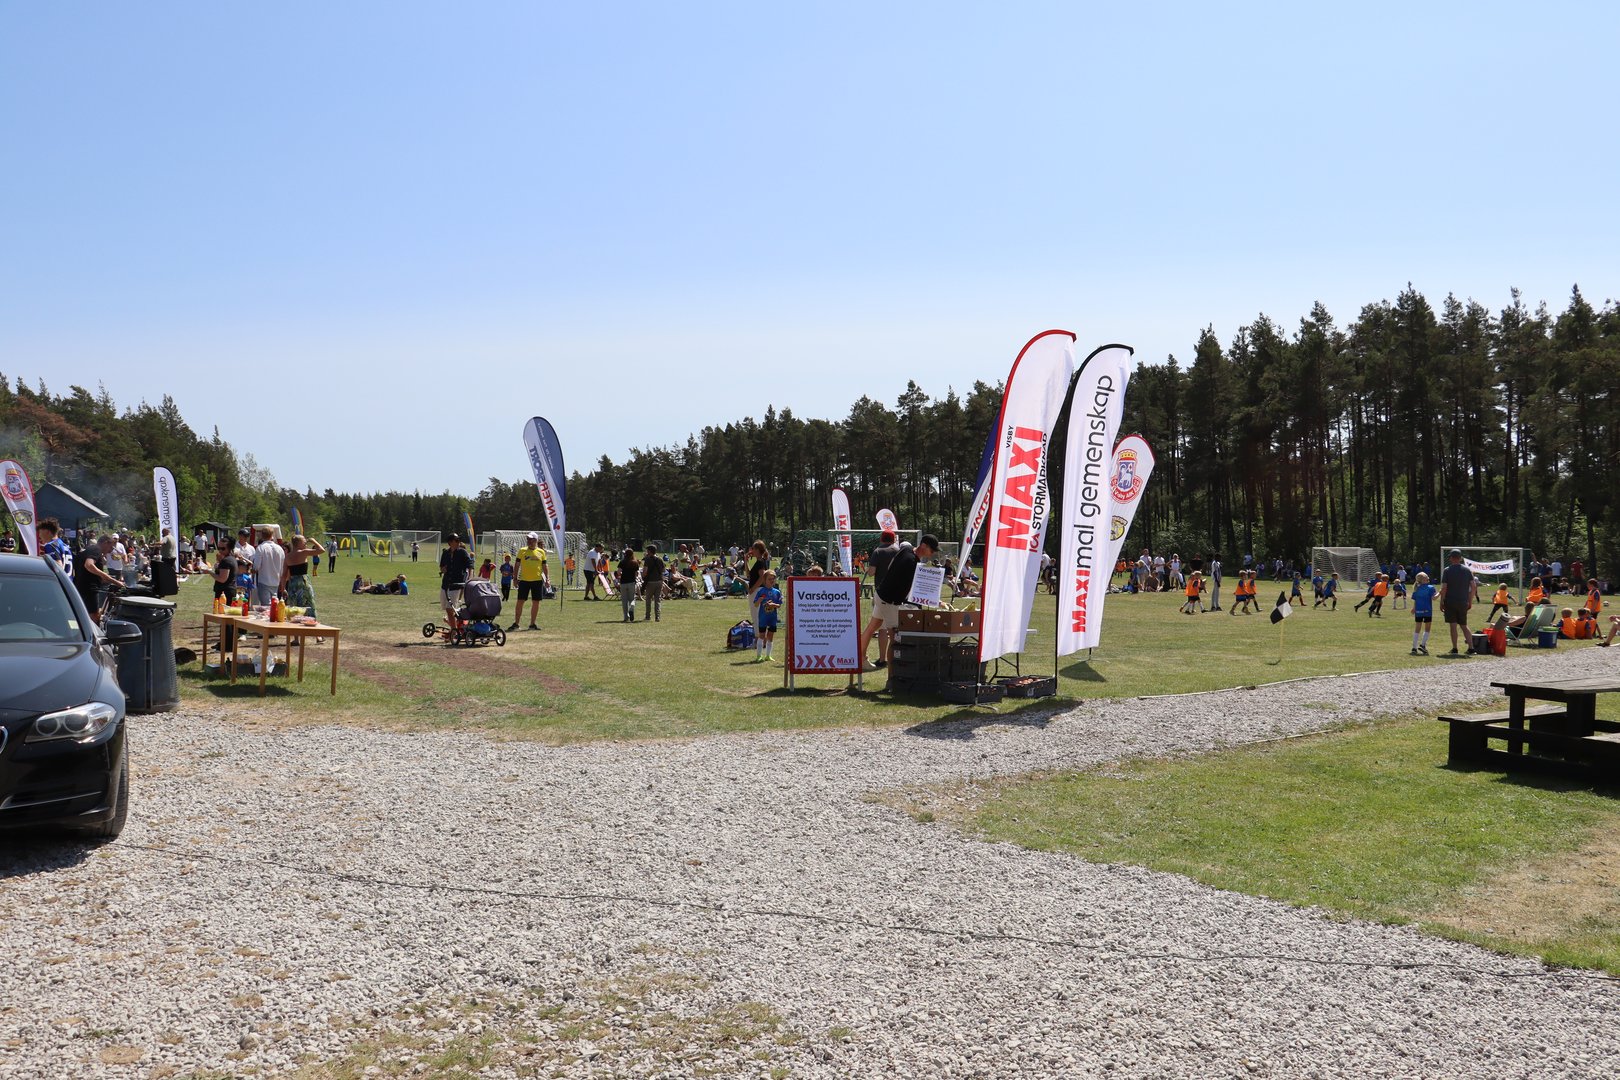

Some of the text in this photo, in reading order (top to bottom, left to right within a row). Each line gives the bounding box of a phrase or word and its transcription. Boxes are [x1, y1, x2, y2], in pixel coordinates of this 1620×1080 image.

[1005, 425, 1015, 449] VISBY
[996, 426, 1044, 551] MAXI
[1072, 374, 1115, 633] MAXImal gemenskap
[1028, 532, 1040, 553] ICA
[798, 590, 850, 602] Varsågod,
